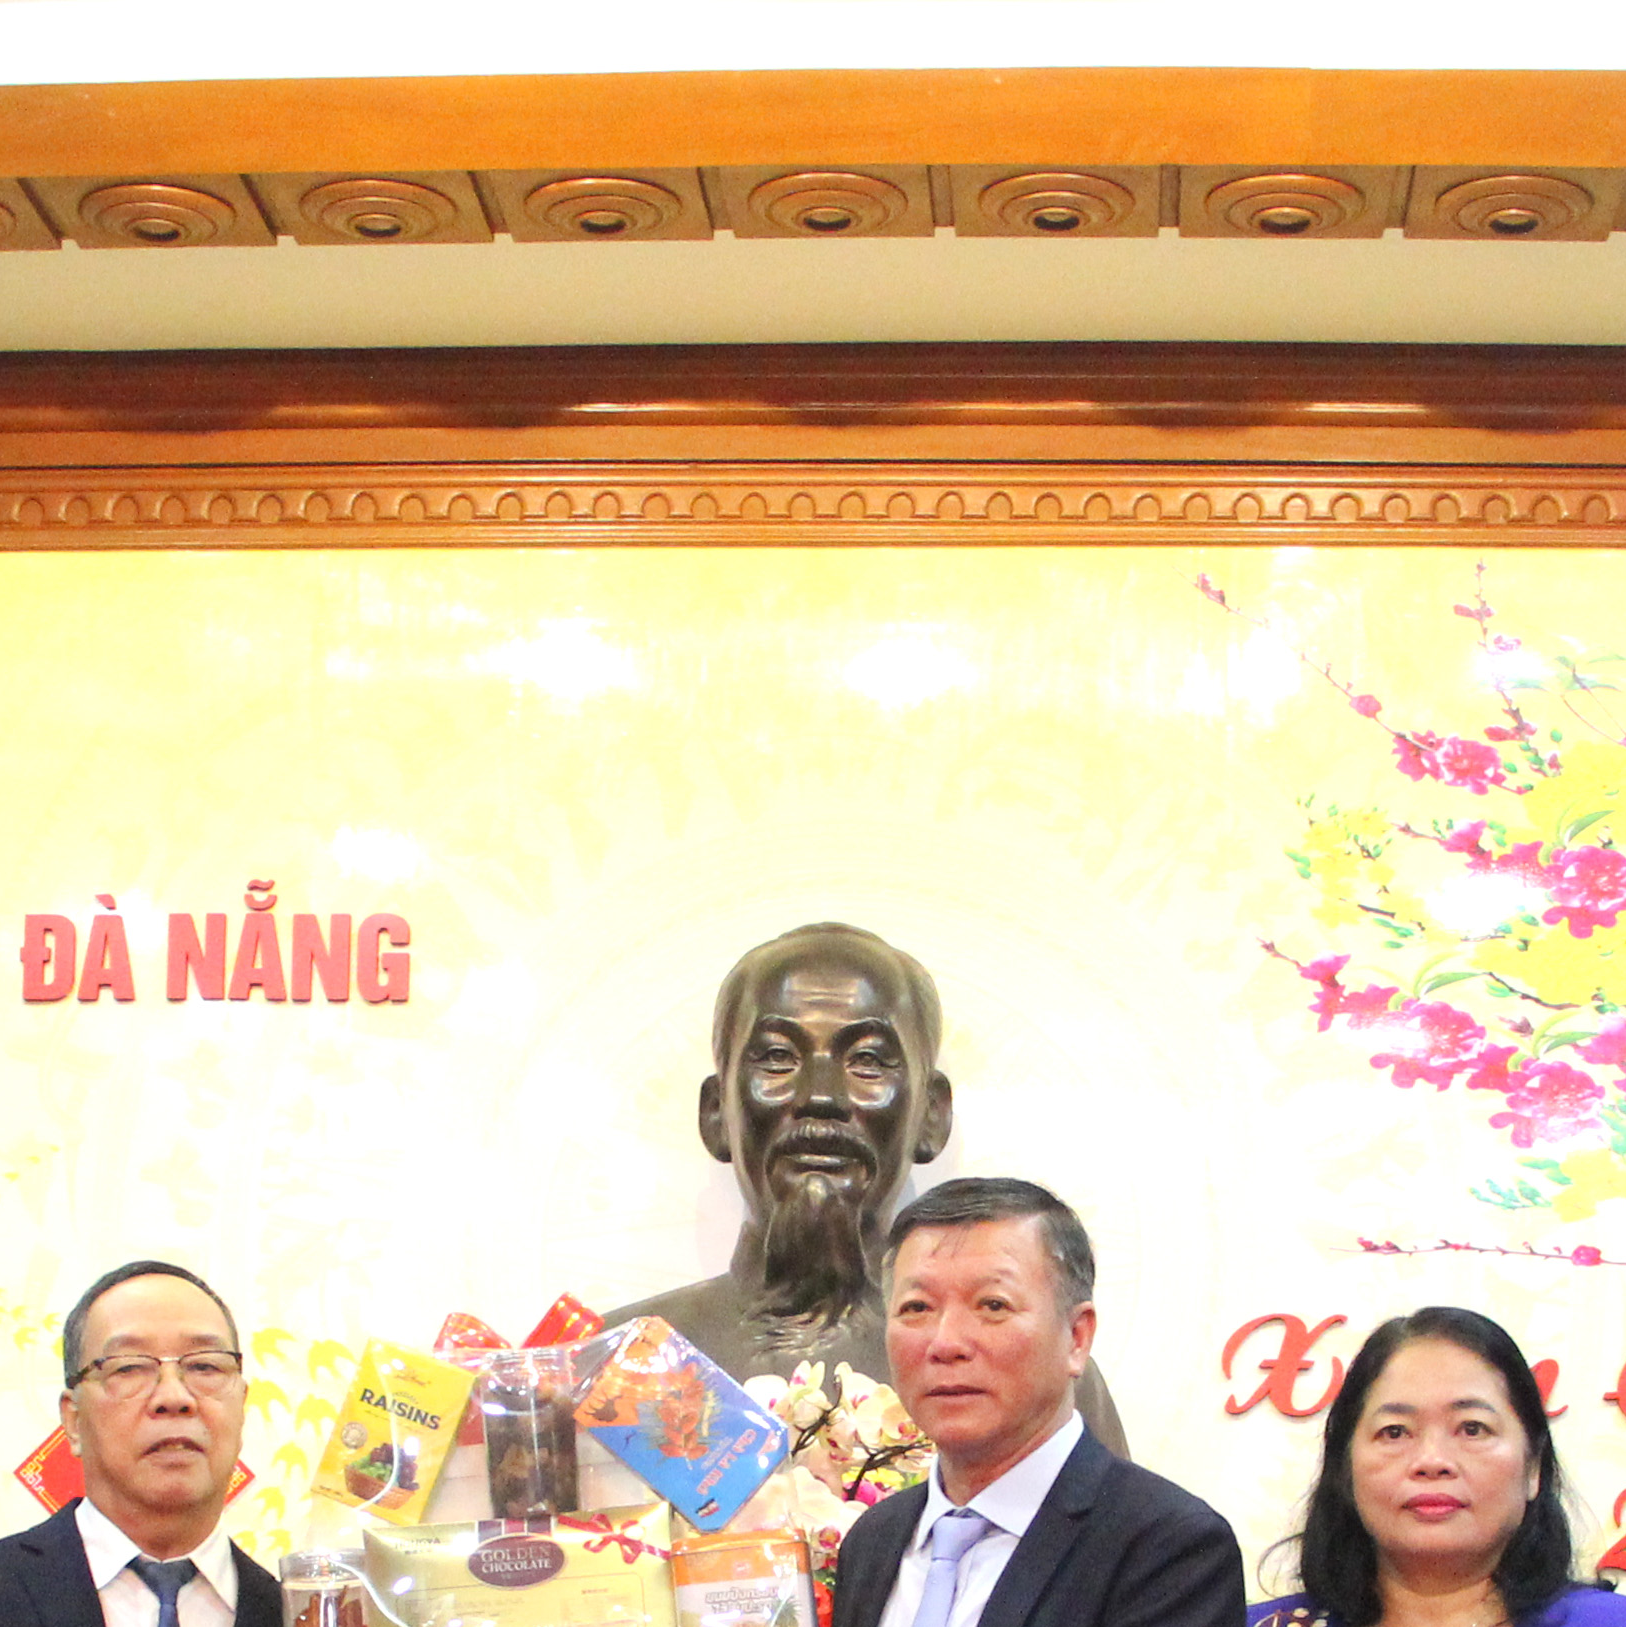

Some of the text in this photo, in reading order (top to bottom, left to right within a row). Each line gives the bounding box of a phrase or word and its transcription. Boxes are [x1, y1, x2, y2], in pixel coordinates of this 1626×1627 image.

[20, 893, 137, 1004] ĐÀ
[167, 879, 412, 1005] NẴNG
[359, 1388, 441, 1431] RAISINS
[480, 1545, 552, 1563] GOLDEN
[481, 1558, 553, 1575] CHOCOLATE
